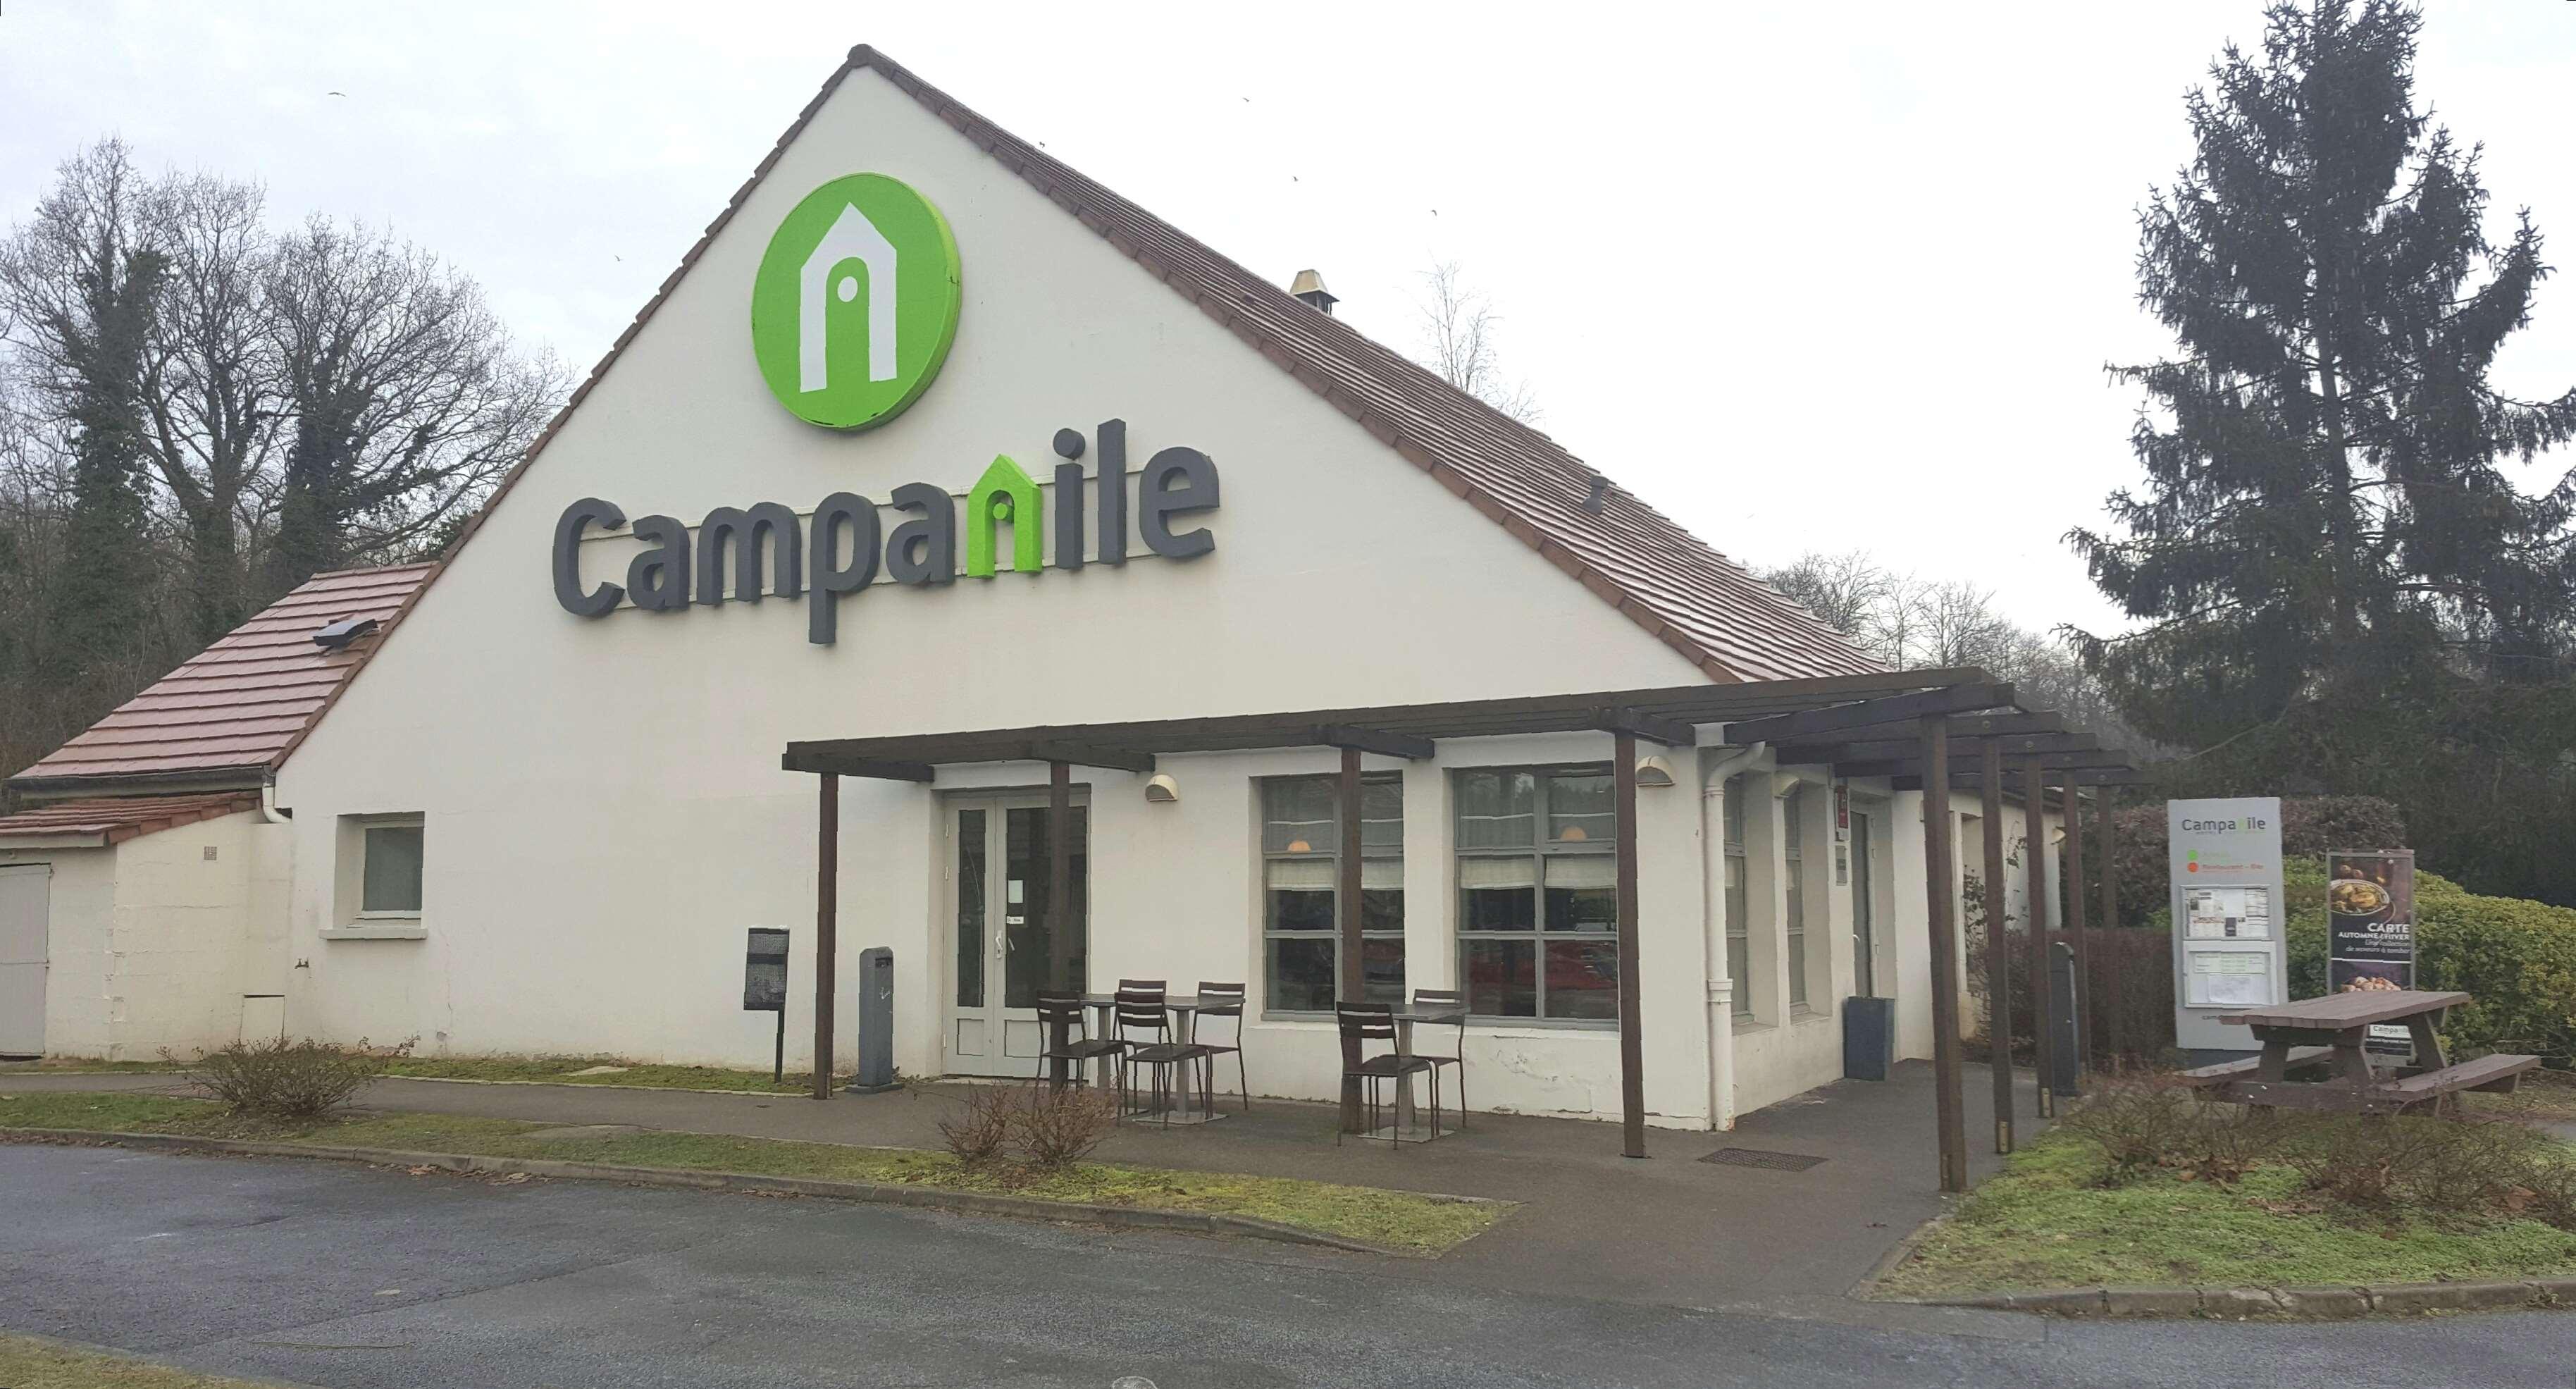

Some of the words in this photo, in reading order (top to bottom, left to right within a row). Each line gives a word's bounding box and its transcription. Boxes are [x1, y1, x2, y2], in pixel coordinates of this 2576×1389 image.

[552, 418, 1220, 645] Campanile
[2367, 922, 2410, 933] CARTE
[2373, 1025, 2408, 1035] Campa
